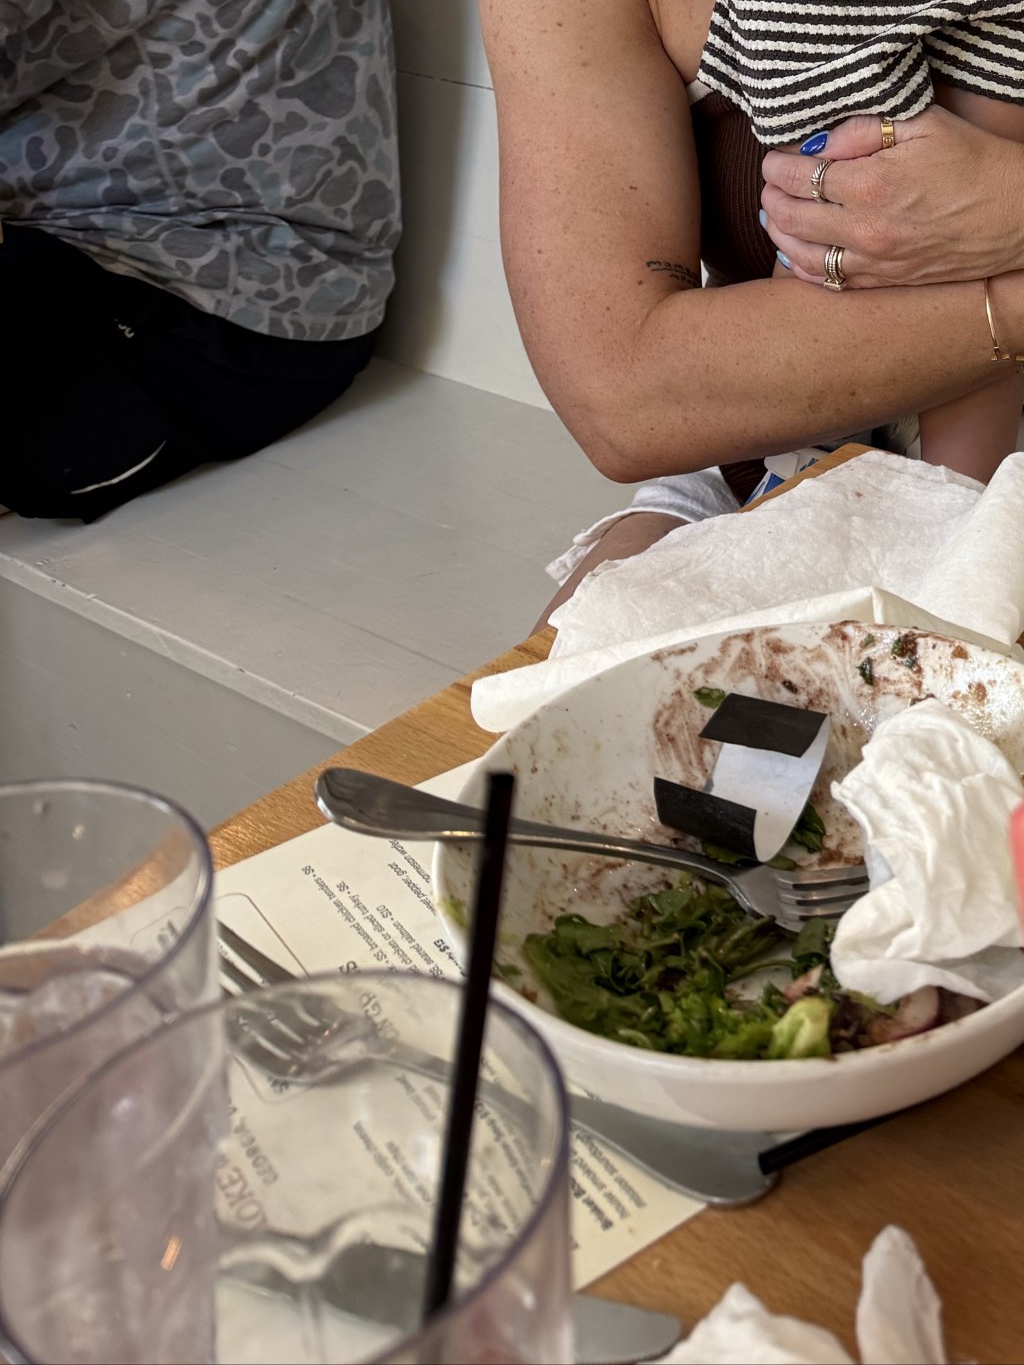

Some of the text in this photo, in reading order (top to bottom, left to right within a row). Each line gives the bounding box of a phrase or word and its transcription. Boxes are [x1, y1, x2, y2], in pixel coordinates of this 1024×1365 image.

[388, 860, 405, 877] goat
[313, 877, 335, 900] tenders
[331, 898, 355, 924] chicken
[347, 892, 369, 915] turkey
[376, 903, 391, 918] $10
[364, 913, 384, 934] sliced
[391, 921, 414, 945] salmon
[381, 932, 390, 940] or
[434, 938, 448, 952] $13
[386, 939, 411, 966] chicken
[410, 943, 433, 966] seared
